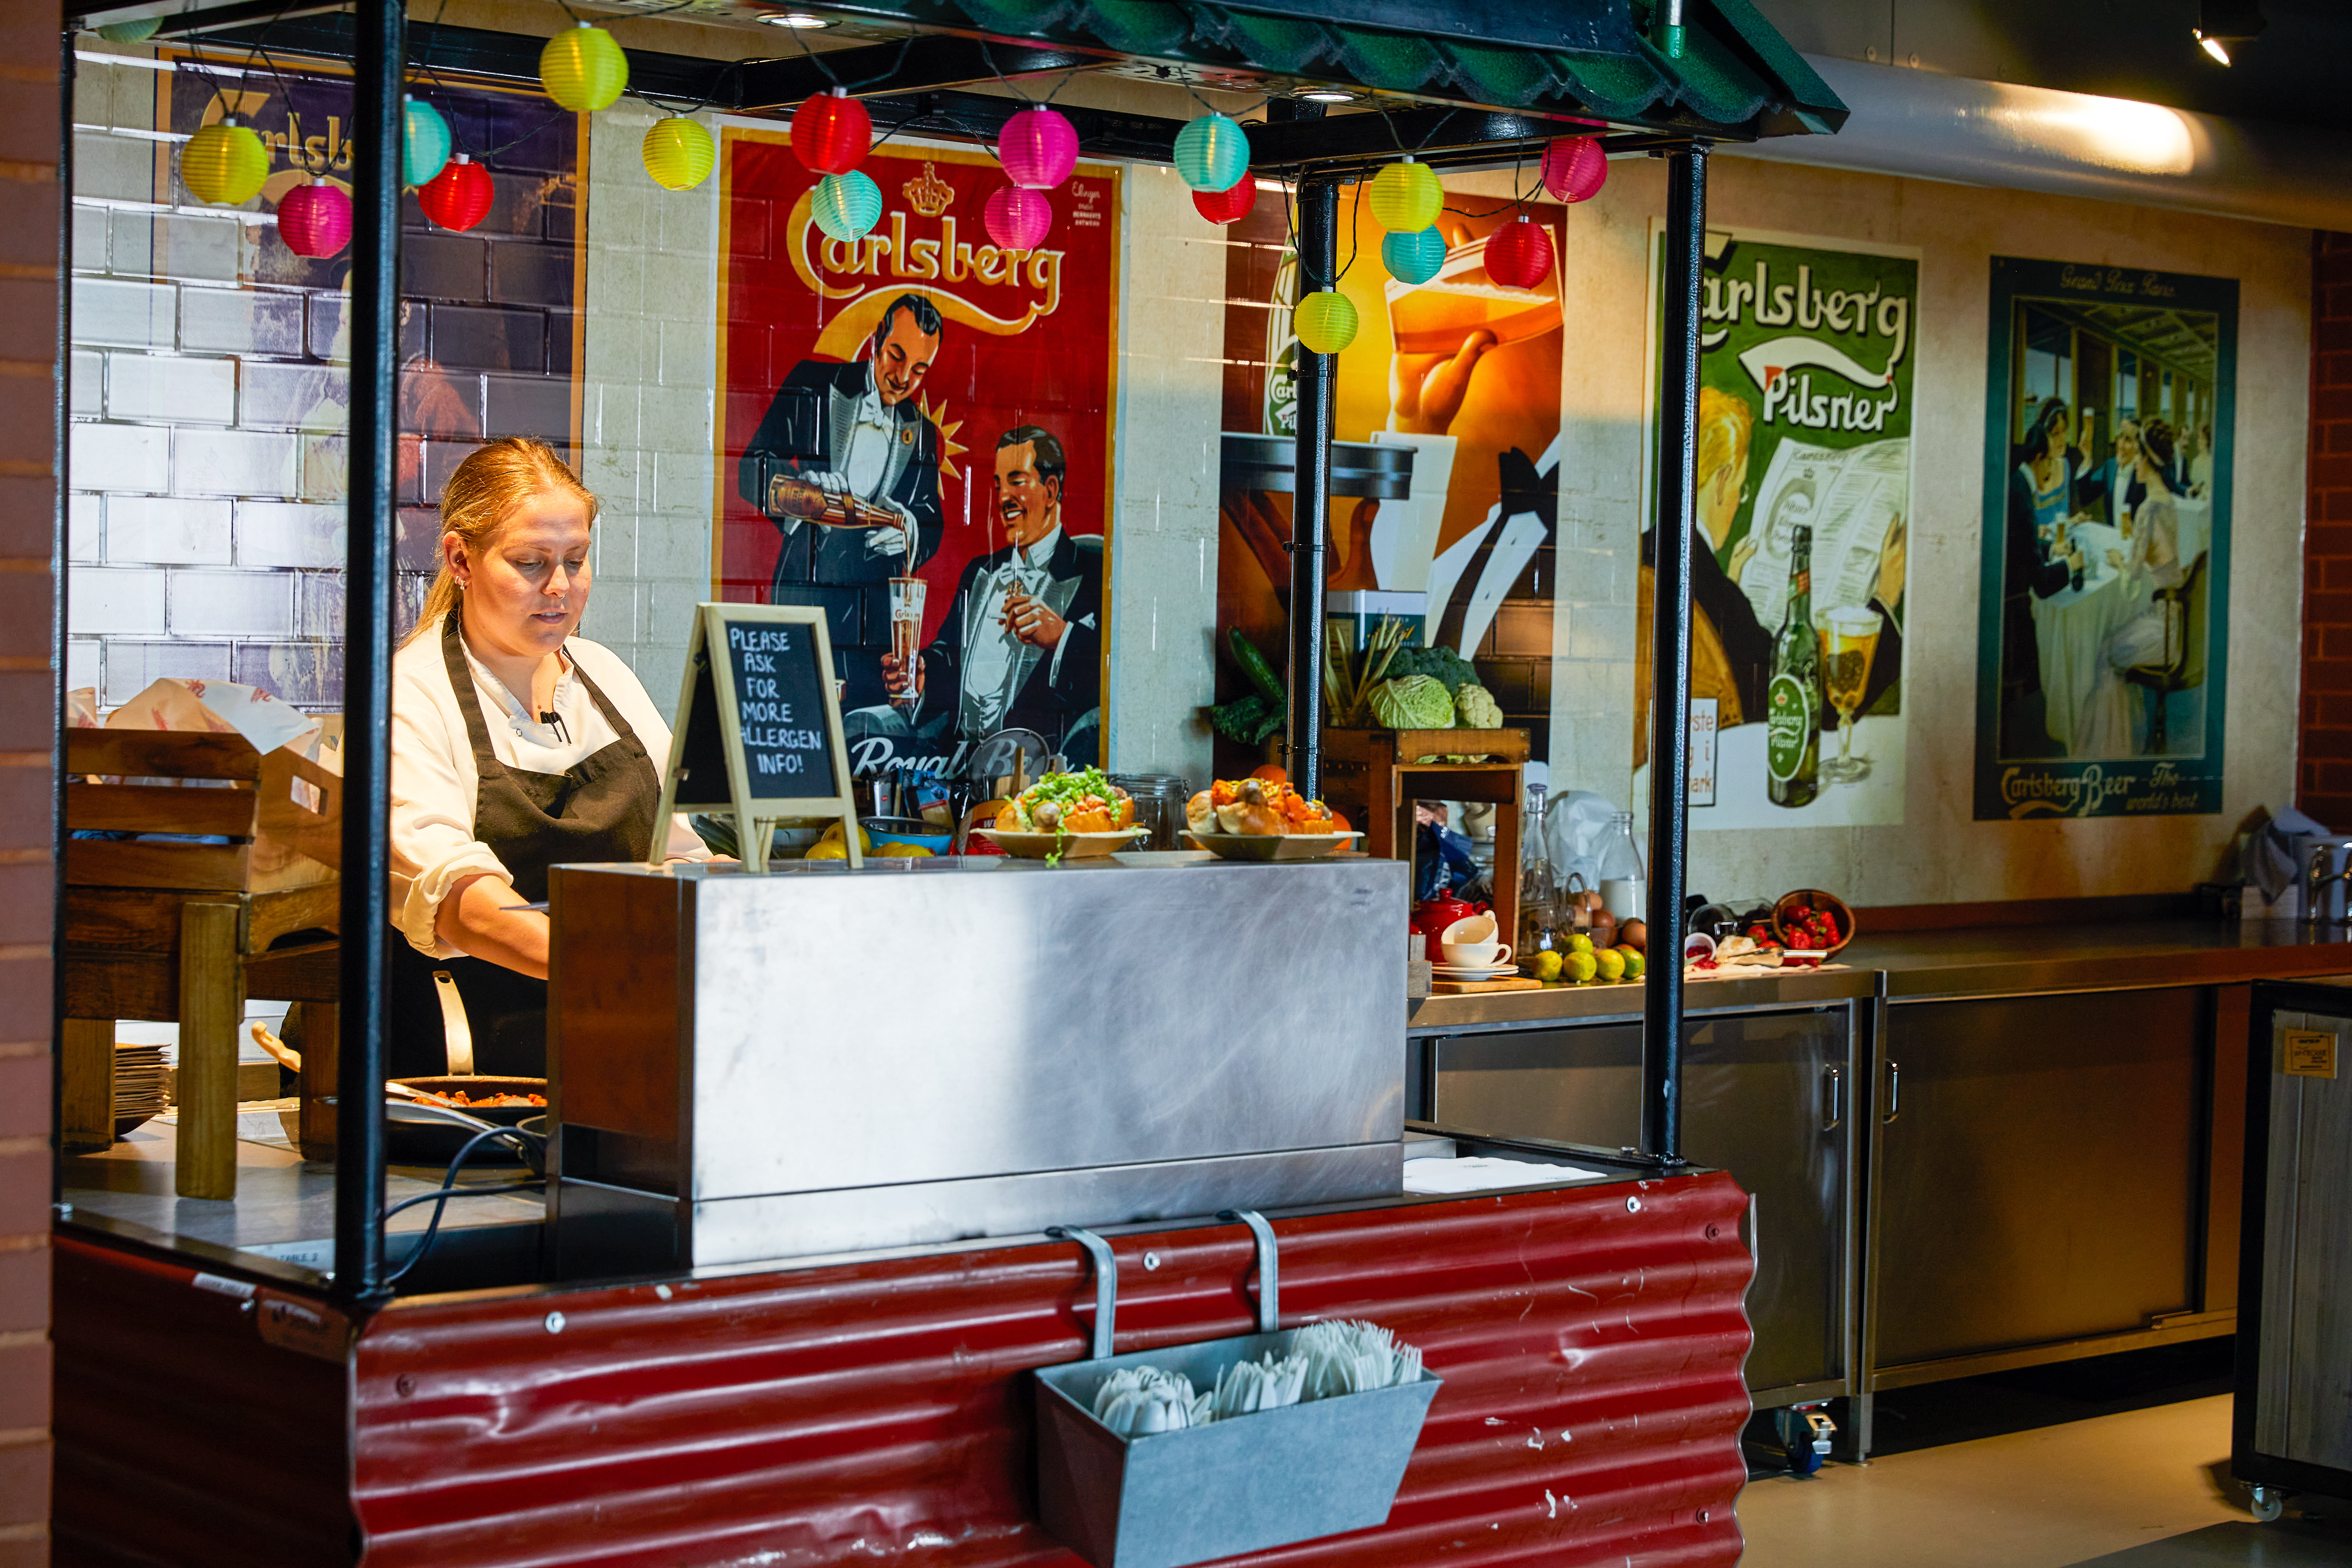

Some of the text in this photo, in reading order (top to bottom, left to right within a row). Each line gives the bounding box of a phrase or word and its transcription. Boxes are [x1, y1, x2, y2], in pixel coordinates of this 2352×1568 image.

[787, 185, 1065, 316] Carlsberg
[1763, 372, 1898, 431] Pilsner
[730, 627, 790, 651] PLEASE
[744, 652, 776, 673] ASK
[746, 677, 780, 698] FOR
[742, 701, 793, 723] MORE
[740, 725, 822, 750] ALLERGEN
[756, 753, 804, 774] INFO!
[1689, 770, 1713, 793] ark
[2001, 761, 2179, 819] Carlsberg Beer The
